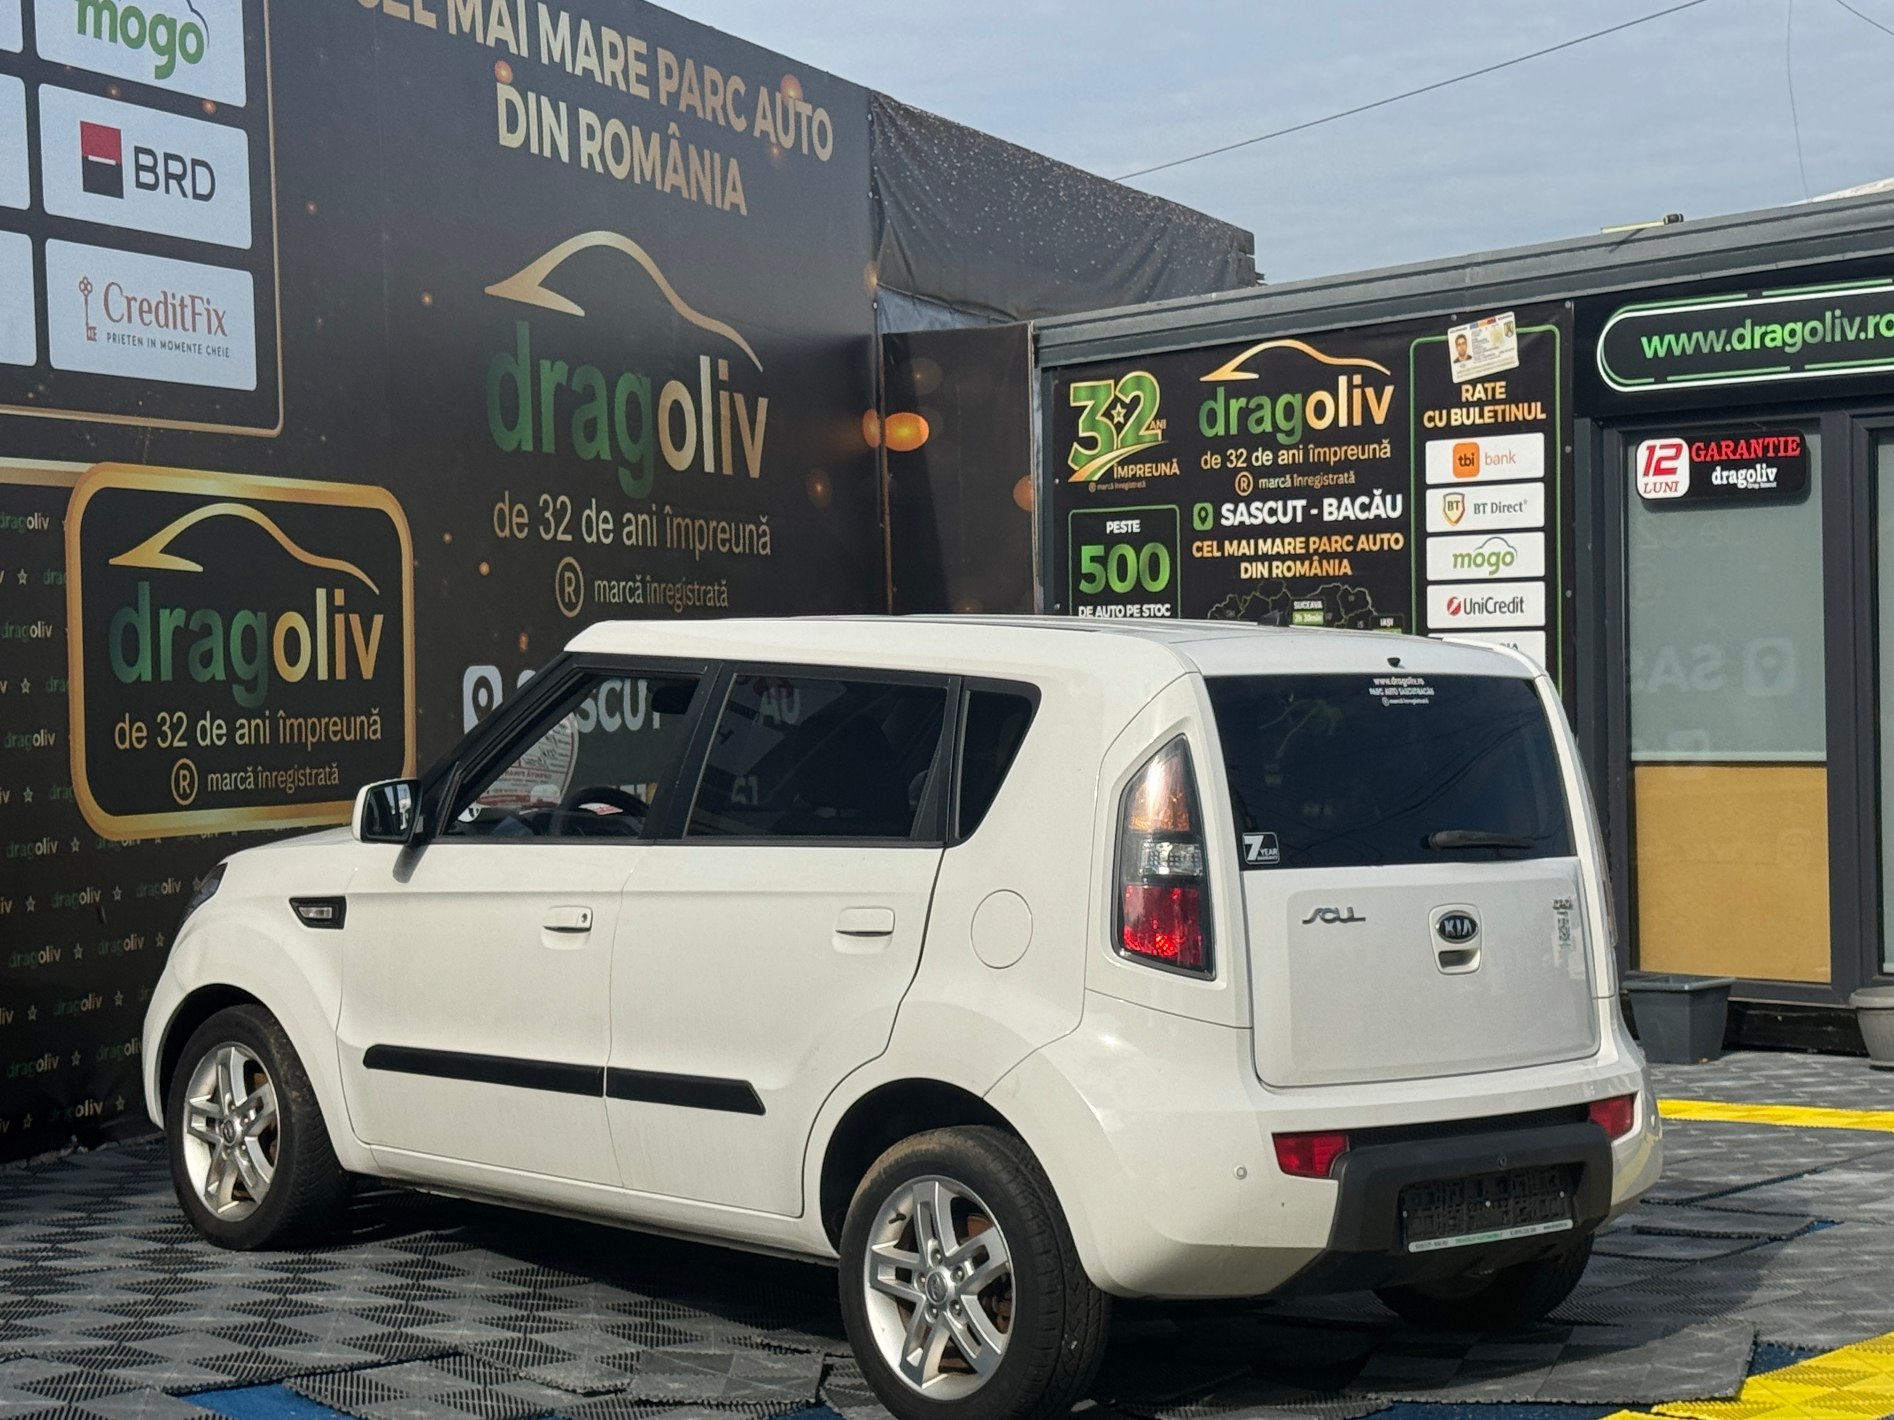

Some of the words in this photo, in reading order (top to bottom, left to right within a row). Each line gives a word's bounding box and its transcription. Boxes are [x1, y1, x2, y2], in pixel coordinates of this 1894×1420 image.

[75, 0, 204, 80] mogo
[448, 0, 528, 58] MAI
[538, 2, 650, 99] MARE
[657, 47, 747, 132] PARC
[753, 86, 834, 162] AUTO
[496, 82, 569, 163] DIN
[579, 107, 747, 216] ROMÂNIA
[134, 146, 215, 202] BRD
[103, 282, 228, 337] CreditFix
[106, 331, 144, 347] PRIETEN
[147, 338, 157, 350] IN
[160, 340, 202, 356] MOMENTE
[205, 344, 230, 358] CHEIE
[1640, 308, 1894, 359] www.dragoliv.ro
[1461, 381, 1506, 402] RATE
[485, 320, 769, 499] dragoliv
[1068, 370, 1161, 471] 32
[1199, 374, 1395, 445] dragoliv
[1423, 409, 1447, 429] CU
[1450, 402, 1546, 426] BULETINUL
[1149, 418, 1167, 430] ANI
[1200, 451, 1221, 469] de
[1226, 448, 1247, 468] 32
[1251, 447, 1273, 466] de
[1277, 445, 1304, 464] ani
[1308, 438, 1391, 466] împreună
[1457, 453, 1475, 468] tbi
[1484, 451, 1516, 466] bank
[1642, 443, 1683, 478] 12
[1691, 436, 1801, 462] GARANTIE
[1113, 458, 1180, 479] ÎMPREUNĂ
[1258, 474, 1291, 489] marcă
[1293, 472, 1356, 490] înregistrată
[1711, 463, 1778, 489] dragoliv
[1643, 481, 1679, 495] LUNI
[1220, 499, 1306, 527] SASCUT
[1323, 489, 1403, 522] BACĂU
[1447, 500, 1461, 512] BT
[1473, 502, 1488, 515] BT
[494, 491, 528, 538] de
[539, 493, 573, 541] 32
[582, 498, 614, 544] de
[622, 505, 657, 547] ani
[664, 507, 771, 560] împreună
[1106, 519, 1141, 534] PESTE
[1192, 541, 1222, 558] CEL
[1224, 540, 1256, 556] MAI
[1257, 537, 1306, 555] MARE
[1309, 535, 1354, 553] PARC
[1356, 533, 1404, 551] AUTO
[1078, 542, 1171, 594] 500
[1240, 562, 1270, 579] DIN
[1273, 556, 1352, 578] ROMÂNIA
[1452, 548, 1515, 576] mogo
[594, 570, 643, 603] marcă
[645, 575, 729, 612] înregistrată
[1078, 605, 1094, 618] DE
[1095, 605, 1125, 618] AUTO
[1126, 604, 1141, 617] PE
[1142, 603, 1171, 617] STOC
[1464, 595, 1525, 615] UniCredit
[1, 621, 53, 642] dragoliv
[109, 580, 384, 708] dragoliv
[5, 729, 56, 751] dragoliv
[115, 712, 147, 749] de
[157, 711, 188, 747] 32
[196, 710, 227, 746] de
[235, 710, 270, 744] ani
[278, 707, 381, 750] împreună
[207, 764, 254, 792] marcă
[257, 762, 339, 794] înregistrată
[6, 837, 59, 859] dragoliv
[1243, 834, 1264, 861] 7
[1260, 848, 1278, 856] YEAR
[50, 887, 101, 909] dragoliv
[136, 878, 182, 899] dragoliv
[1443, 920, 1474, 938] KIA
[8, 945, 61, 968] dragoliv
[98, 933, 145, 956] dragoliv
[52, 993, 103, 1017] dragoliv
[7, 1052, 60, 1078] dragoliv
